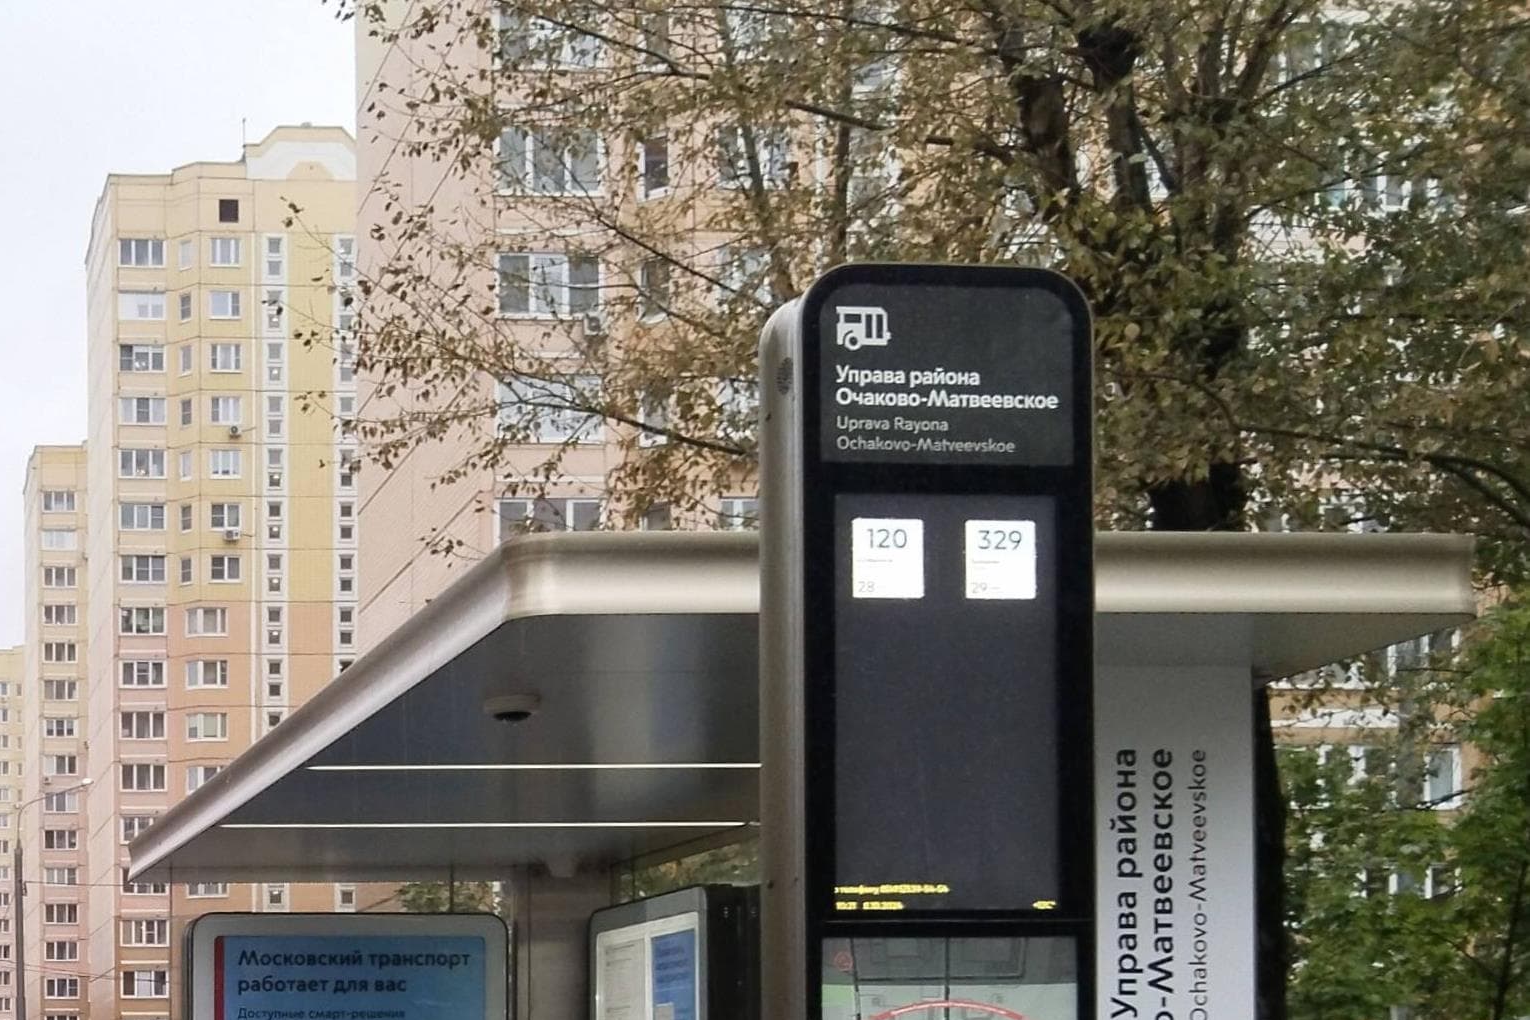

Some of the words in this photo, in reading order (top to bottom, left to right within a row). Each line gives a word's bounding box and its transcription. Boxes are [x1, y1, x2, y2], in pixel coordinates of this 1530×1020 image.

[836, 364, 906, 387] Управа
[909, 367, 981, 388] района
[836, 388, 1059, 409] Очаково-Матвеевское
[836, 415, 891, 432] Uprava
[894, 416, 949, 434] Rayona
[836, 435, 1016, 453] Ochakovo-Matveevskoe
[866, 528, 908, 549] 120
[978, 529, 1022, 550] 329
[1109, 748, 1143, 878] района
[238, 949, 363, 967] Московский
[369, 952, 471, 970] транспорт
[1110, 890, 1143, 1019] Управа
[238, 976, 329, 995] работает
[333, 980, 368, 994] для
[374, 979, 407, 993] вас
[237, 1007, 305, 1020] Доступные
[308, 1009, 406, 1020] смарт-решения
